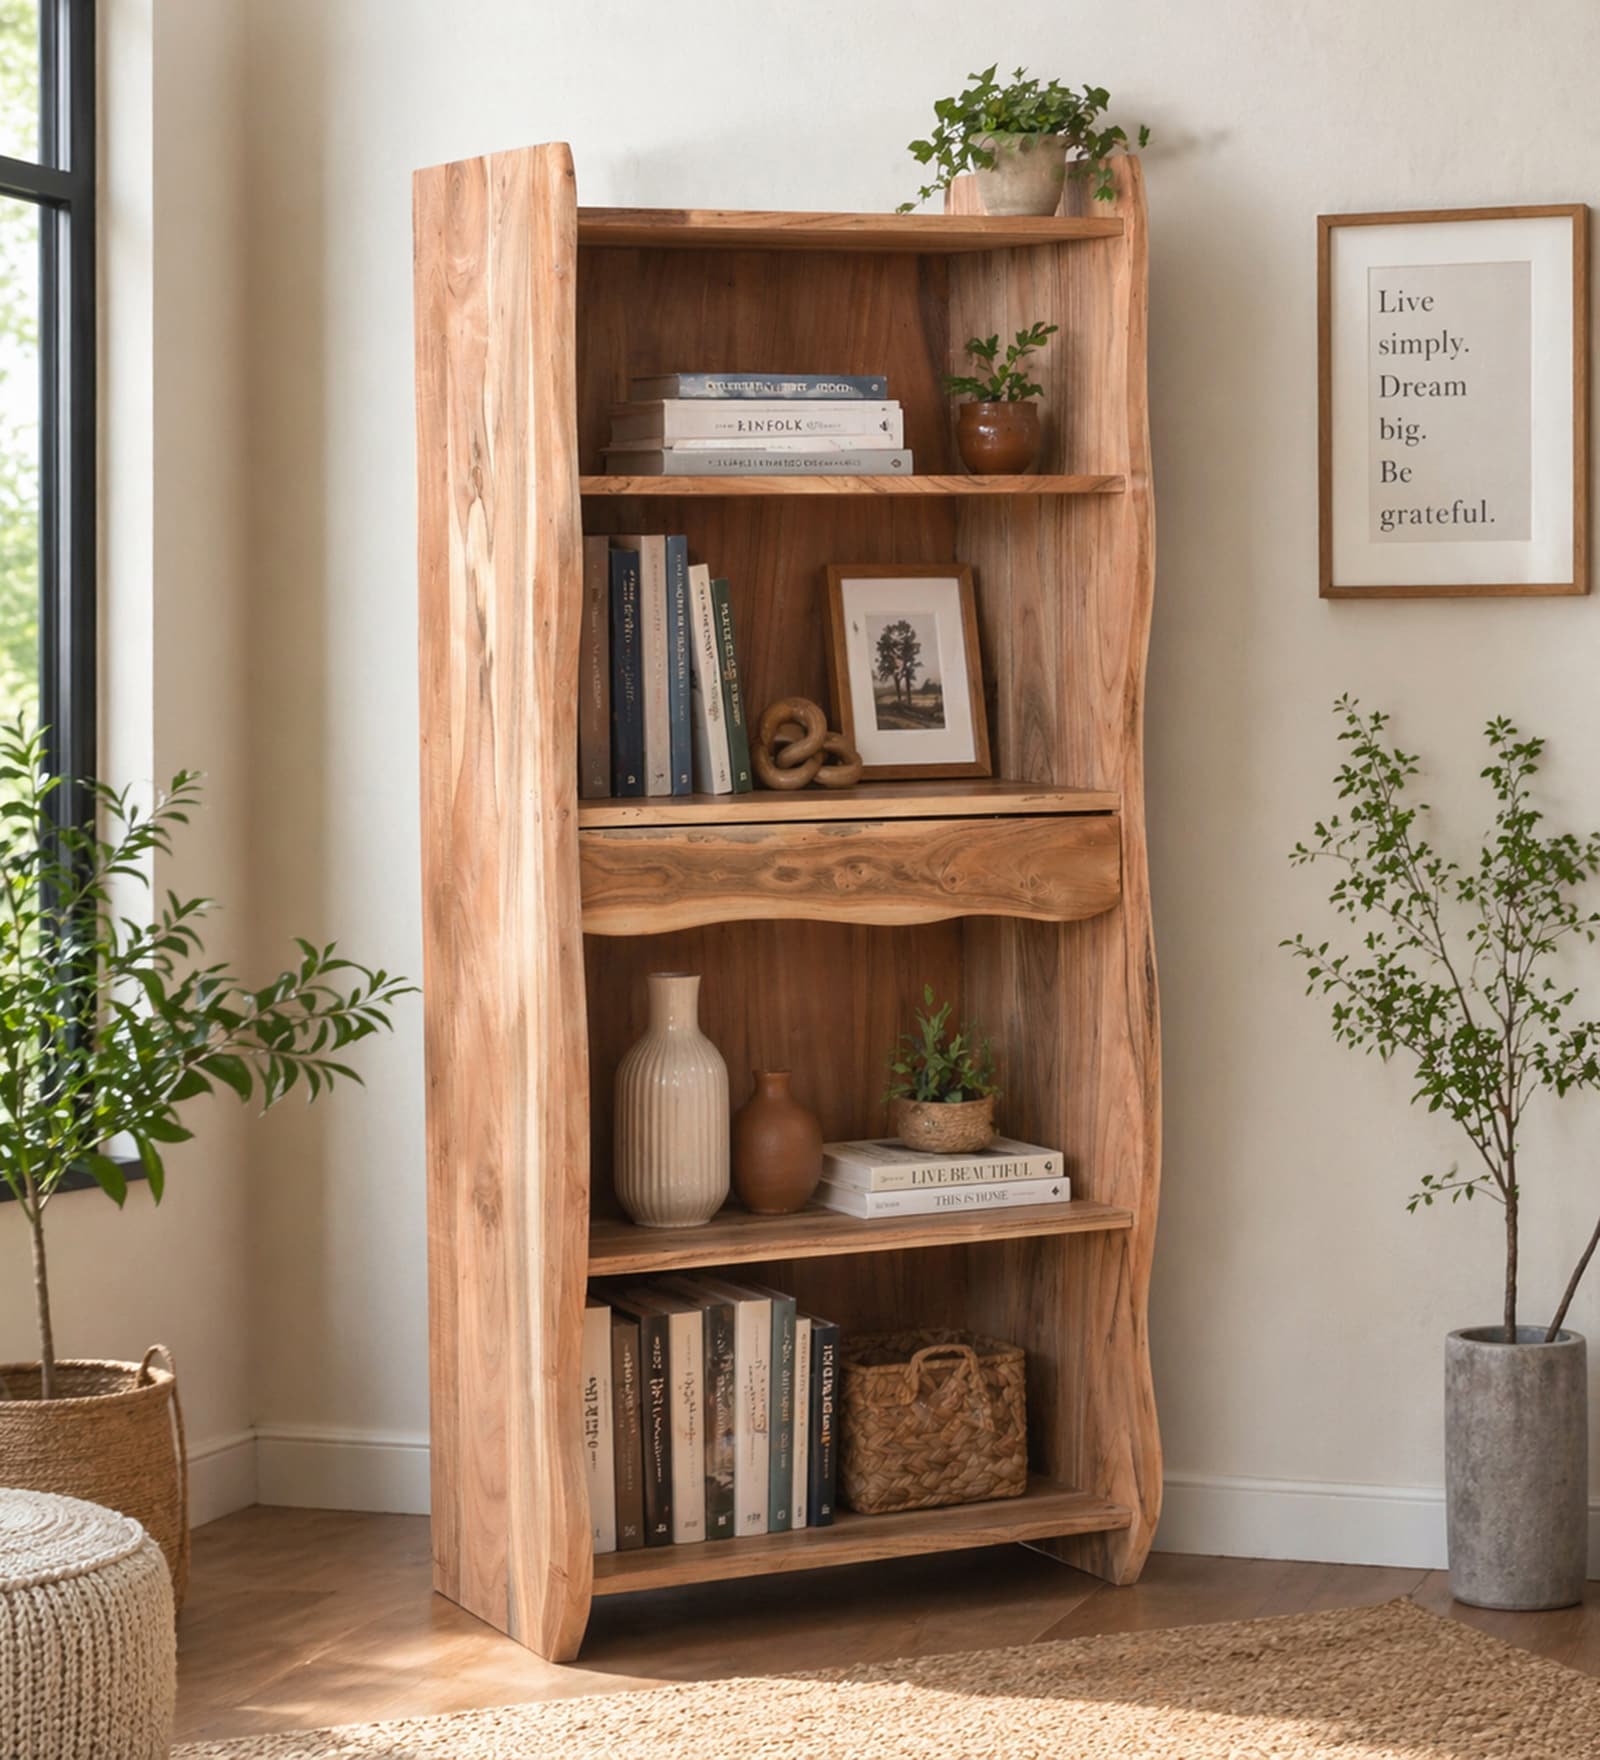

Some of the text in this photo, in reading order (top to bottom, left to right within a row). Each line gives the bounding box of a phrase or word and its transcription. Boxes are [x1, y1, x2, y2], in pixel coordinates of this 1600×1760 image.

[1379, 290, 1435, 314] Live
[1378, 330, 1470, 361] simply.
[1379, 374, 1467, 398] Dream
[1380, 417, 1427, 447] big.
[1380, 460, 1413, 484] Be
[1380, 499, 1496, 532] grateful.
[911, 1169, 945, 1185] LIVE
[950, 1162, 1033, 1181] BEAUTIFUL
[934, 1194, 962, 1207] THIS
[963, 1193, 974, 1204] IS
